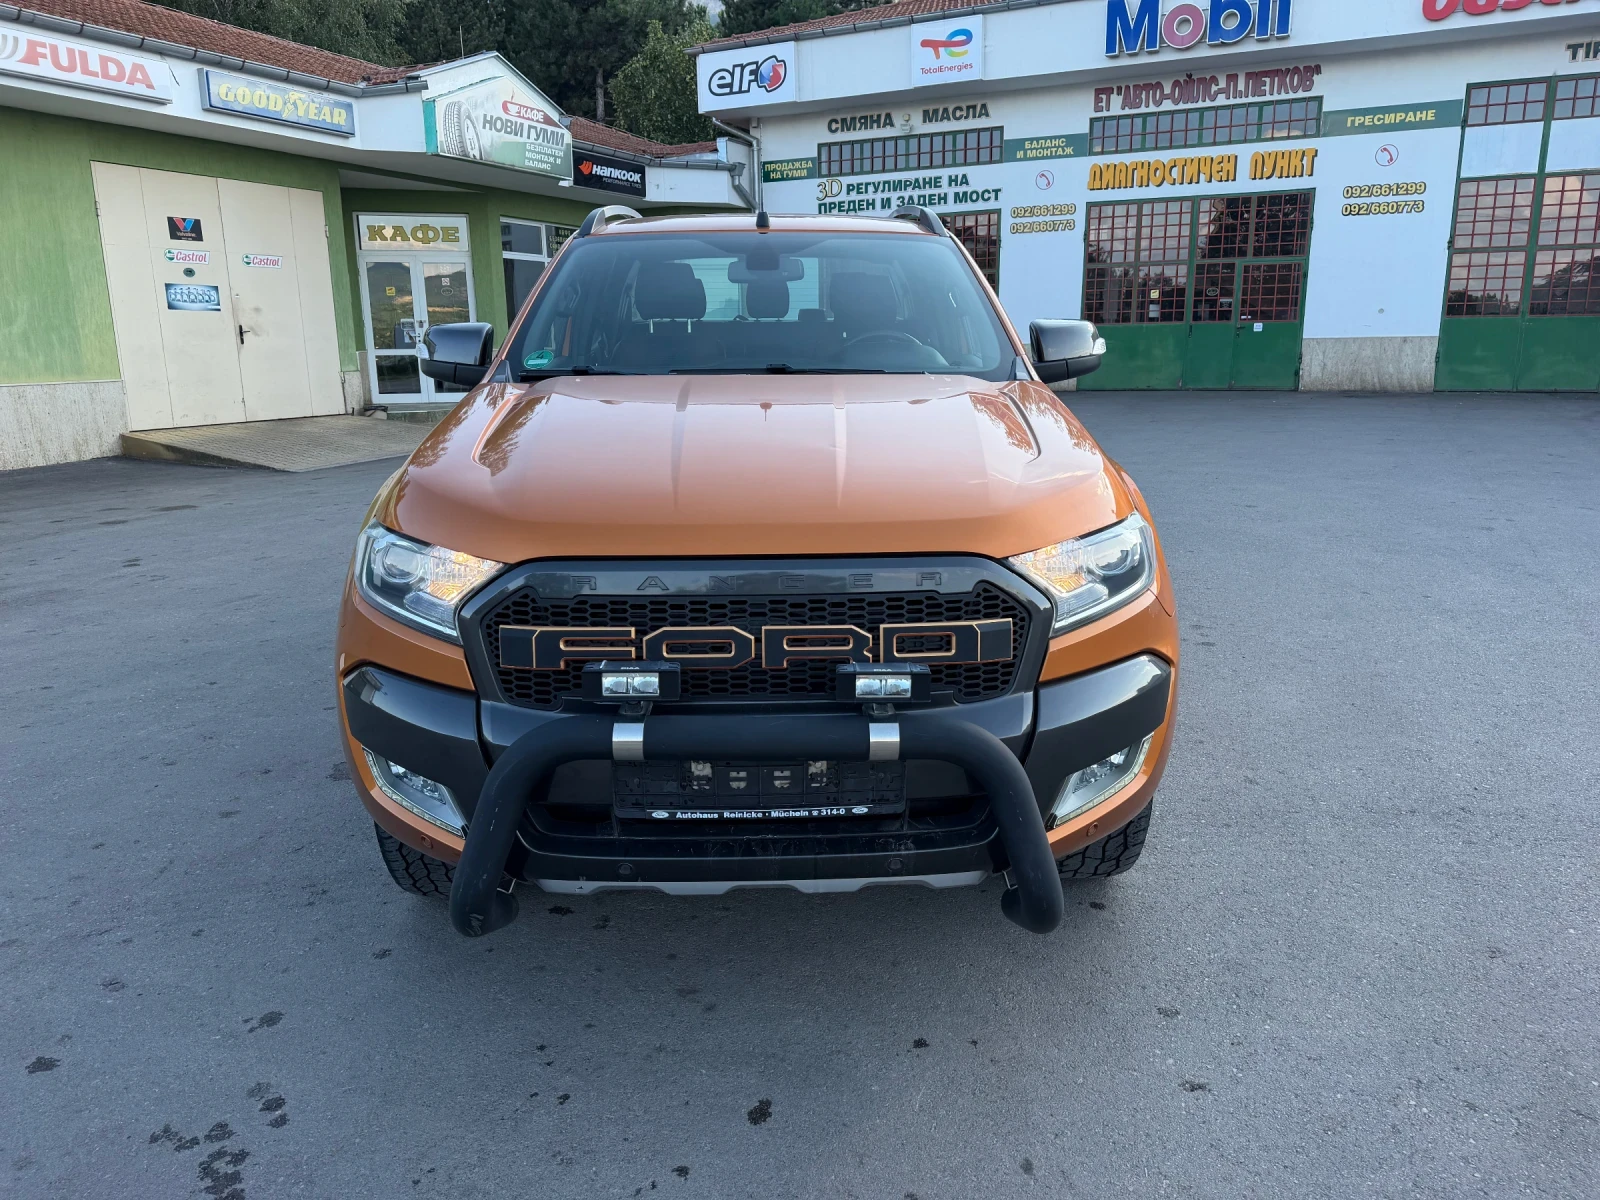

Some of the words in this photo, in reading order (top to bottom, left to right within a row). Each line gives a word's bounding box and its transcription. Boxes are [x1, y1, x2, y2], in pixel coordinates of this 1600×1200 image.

[16, 38, 156, 90] FULDA
[920, 61, 973, 75] TotalEnergies
[708, 60, 760, 96] elf
[1094, 86, 1114, 112] ЕТ
[520, 106, 544, 122] КАФЕ
[827, 112, 895, 134] СМЯНА
[922, 103, 990, 124] МАСЛА
[1347, 109, 1436, 127] ГРЕСИРАНЕ
[482, 113, 524, 138] НОВИ
[527, 124, 565, 148] ГУМИ
[526, 143, 564, 157] БЕЗПЛАТЕН
[1025, 138, 1066, 149] БАЛАНС
[525, 151, 555, 163] МОНТАЖ
[1016, 150, 1024, 158] И
[1027, 146, 1074, 158] МОНТАЖ
[525, 159, 551, 170] БАЛАНС
[765, 161, 813, 172] ПРОДАЖБА
[1087, 153, 1237, 191] ДИАГНОСТИЧЕН
[1249, 148, 1318, 180] ПУНКТ
[770, 171, 782, 180] НА
[783, 169, 807, 179] ГУМИ
[816, 178, 843, 201] 3D
[846, 176, 942, 196] РЕГУЛИРАНЕ
[948, 173, 970, 188] НА
[1343, 182, 1426, 199] 092/661299
[817, 197, 876, 214] ПРЕДЕН
[881, 197, 891, 210] И
[896, 191, 948, 207] ЗАДЕН
[953, 188, 1002, 204] МОСТ
[1342, 200, 1424, 216] 092/660773
[1010, 203, 1076, 219] 092/661299
[366, 223, 460, 245] КАФЕ
[1010, 219, 1075, 235] 092/660773
[175, 251, 207, 263] Castrol
[251, 256, 280, 267] Castrol
[536, 351, 544, 359] 4
[570, 571, 942, 592] RANGER
[500, 618, 1013, 669] FORD
[676, 811, 718, 819] Autohaus
